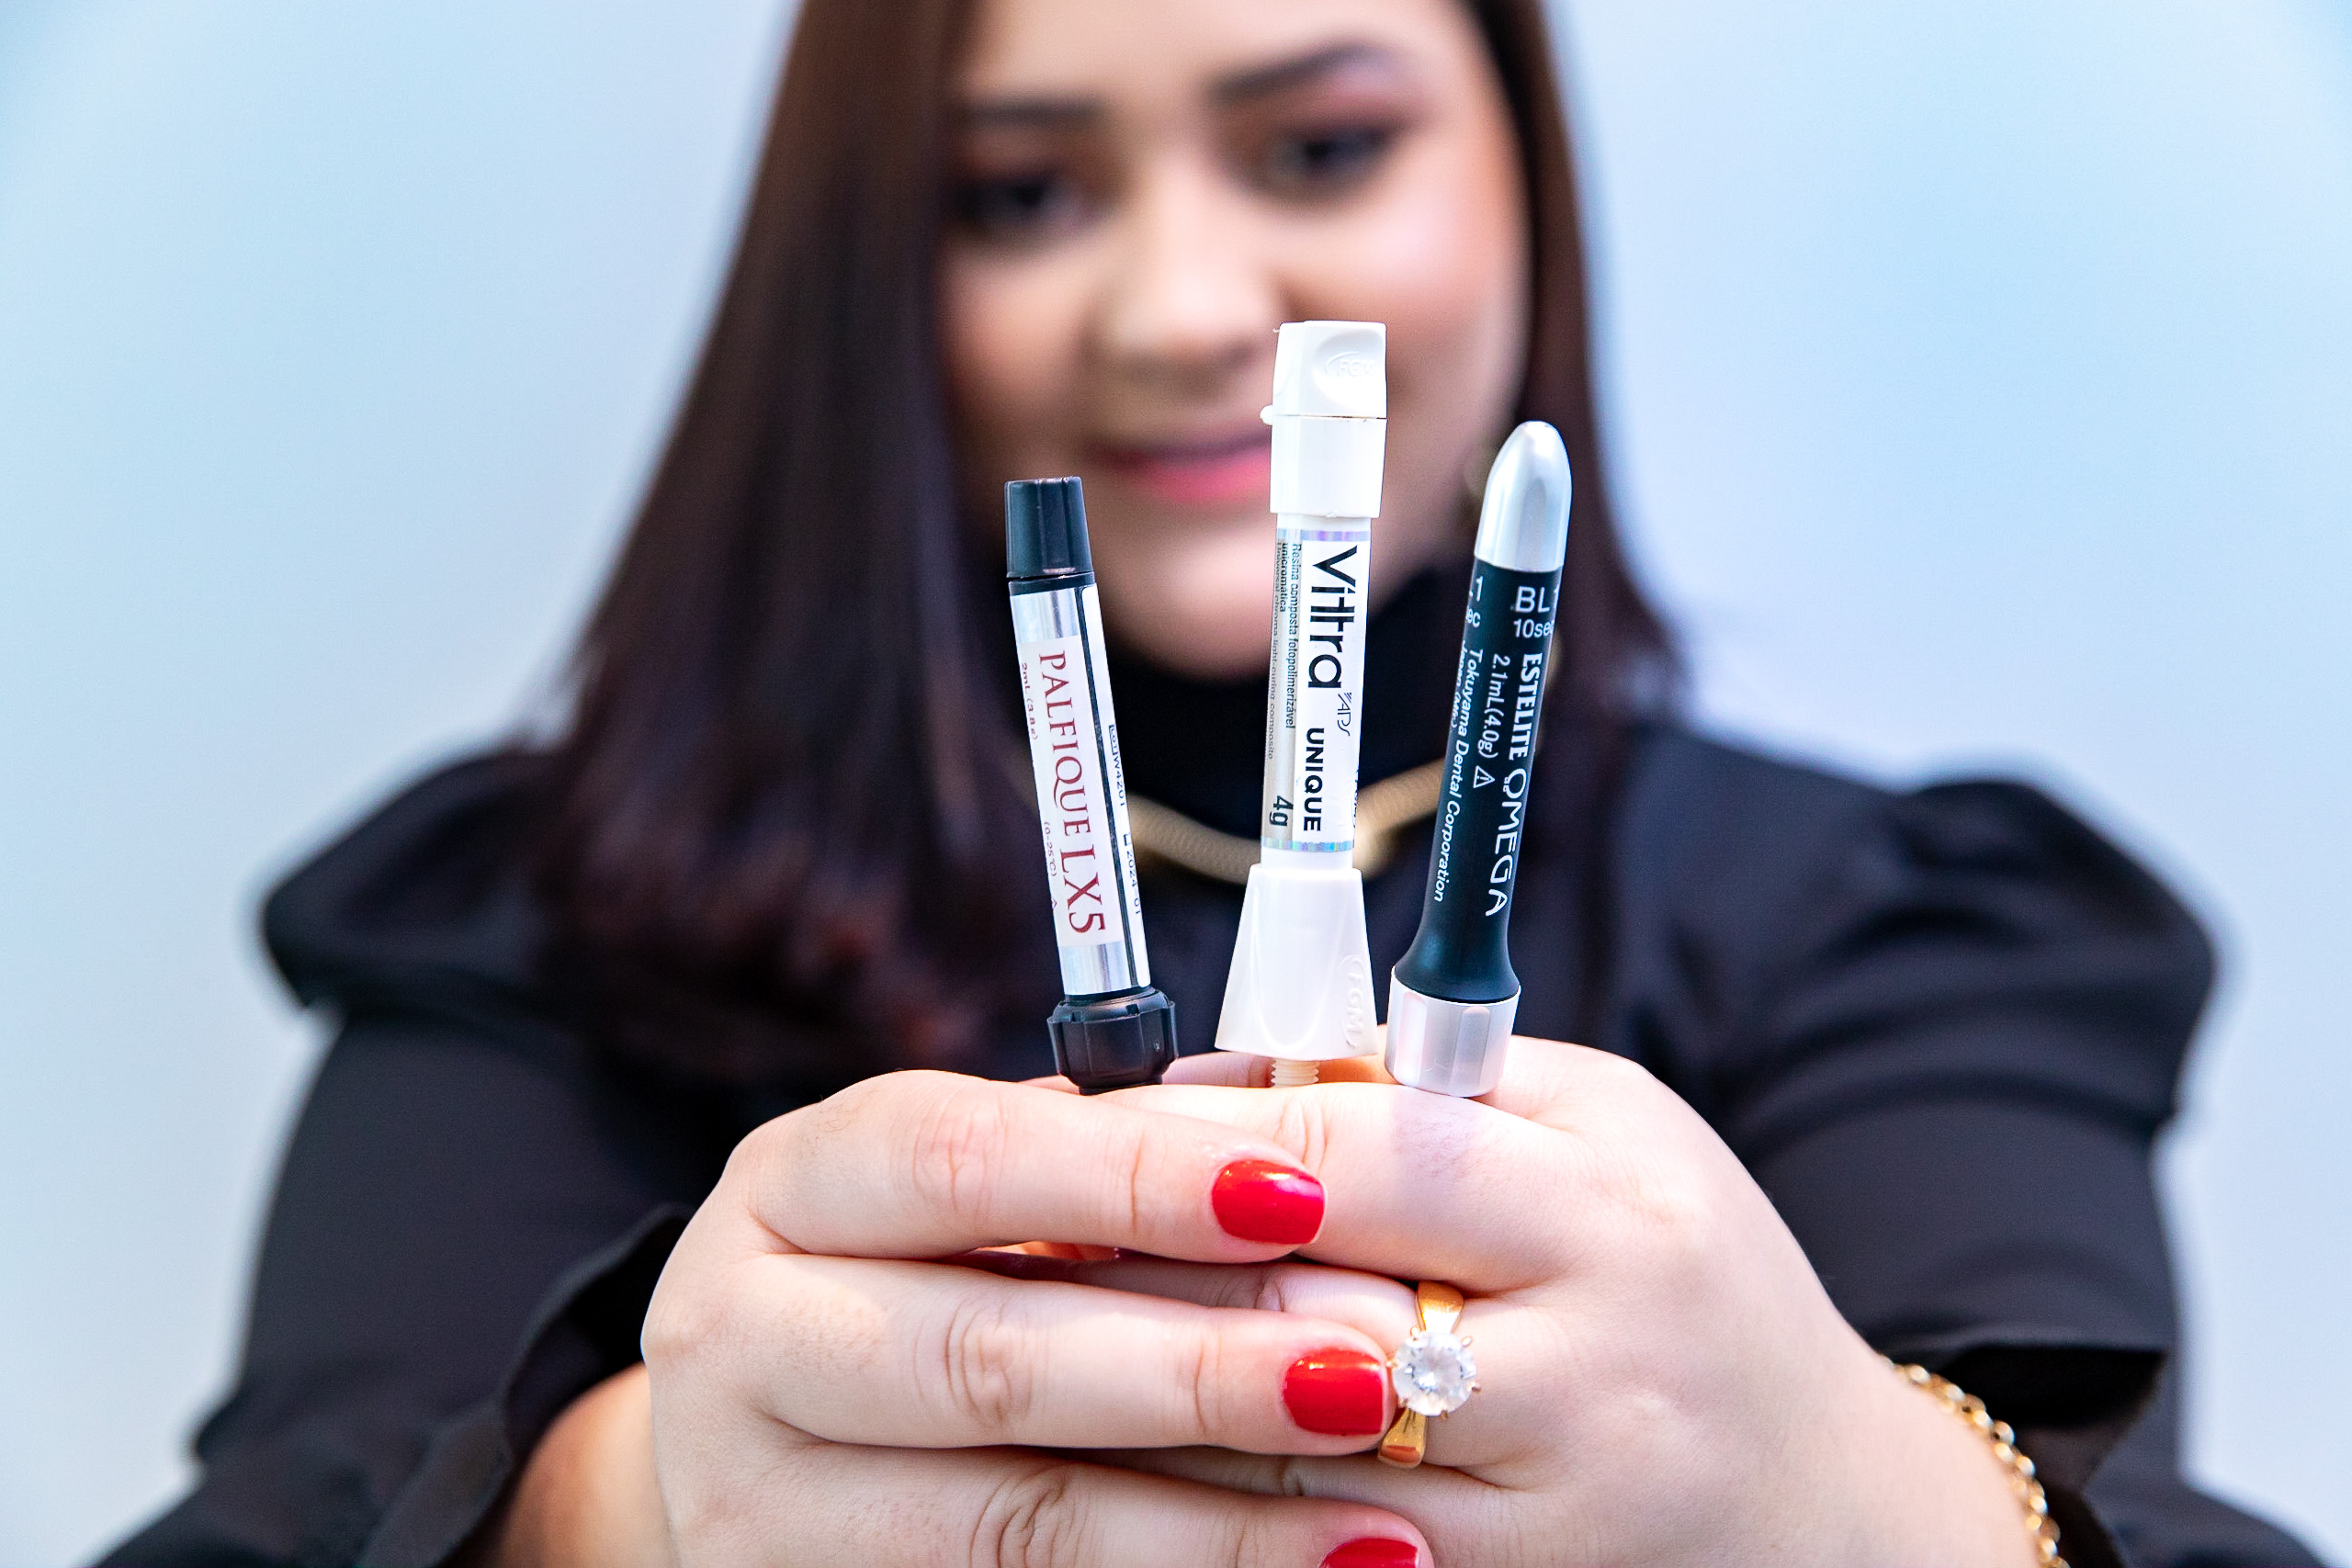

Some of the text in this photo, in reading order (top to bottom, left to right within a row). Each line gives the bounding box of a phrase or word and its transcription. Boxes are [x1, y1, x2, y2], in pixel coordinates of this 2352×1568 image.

[1285, 544, 1302, 728] Resina composta fotopolimerizável
[1308, 545, 1359, 688] Vittra
[1458, 649, 1484, 737] Tokuyama
[1477, 653, 1511, 759] 2.1mL(4.0g)
[1509, 652, 1544, 761] ESTELITE
[1038, 650, 1105, 935] PALFIQUE LX5
[1269, 795, 1294, 827] 4g
[1303, 728, 1325, 831] UNIQUE
[1449, 739, 1470, 798] Dental
[1113, 754, 1127, 807] W4201
[1125, 849, 1141, 916] 2024-01
[1433, 800, 1461, 902] Corporation
